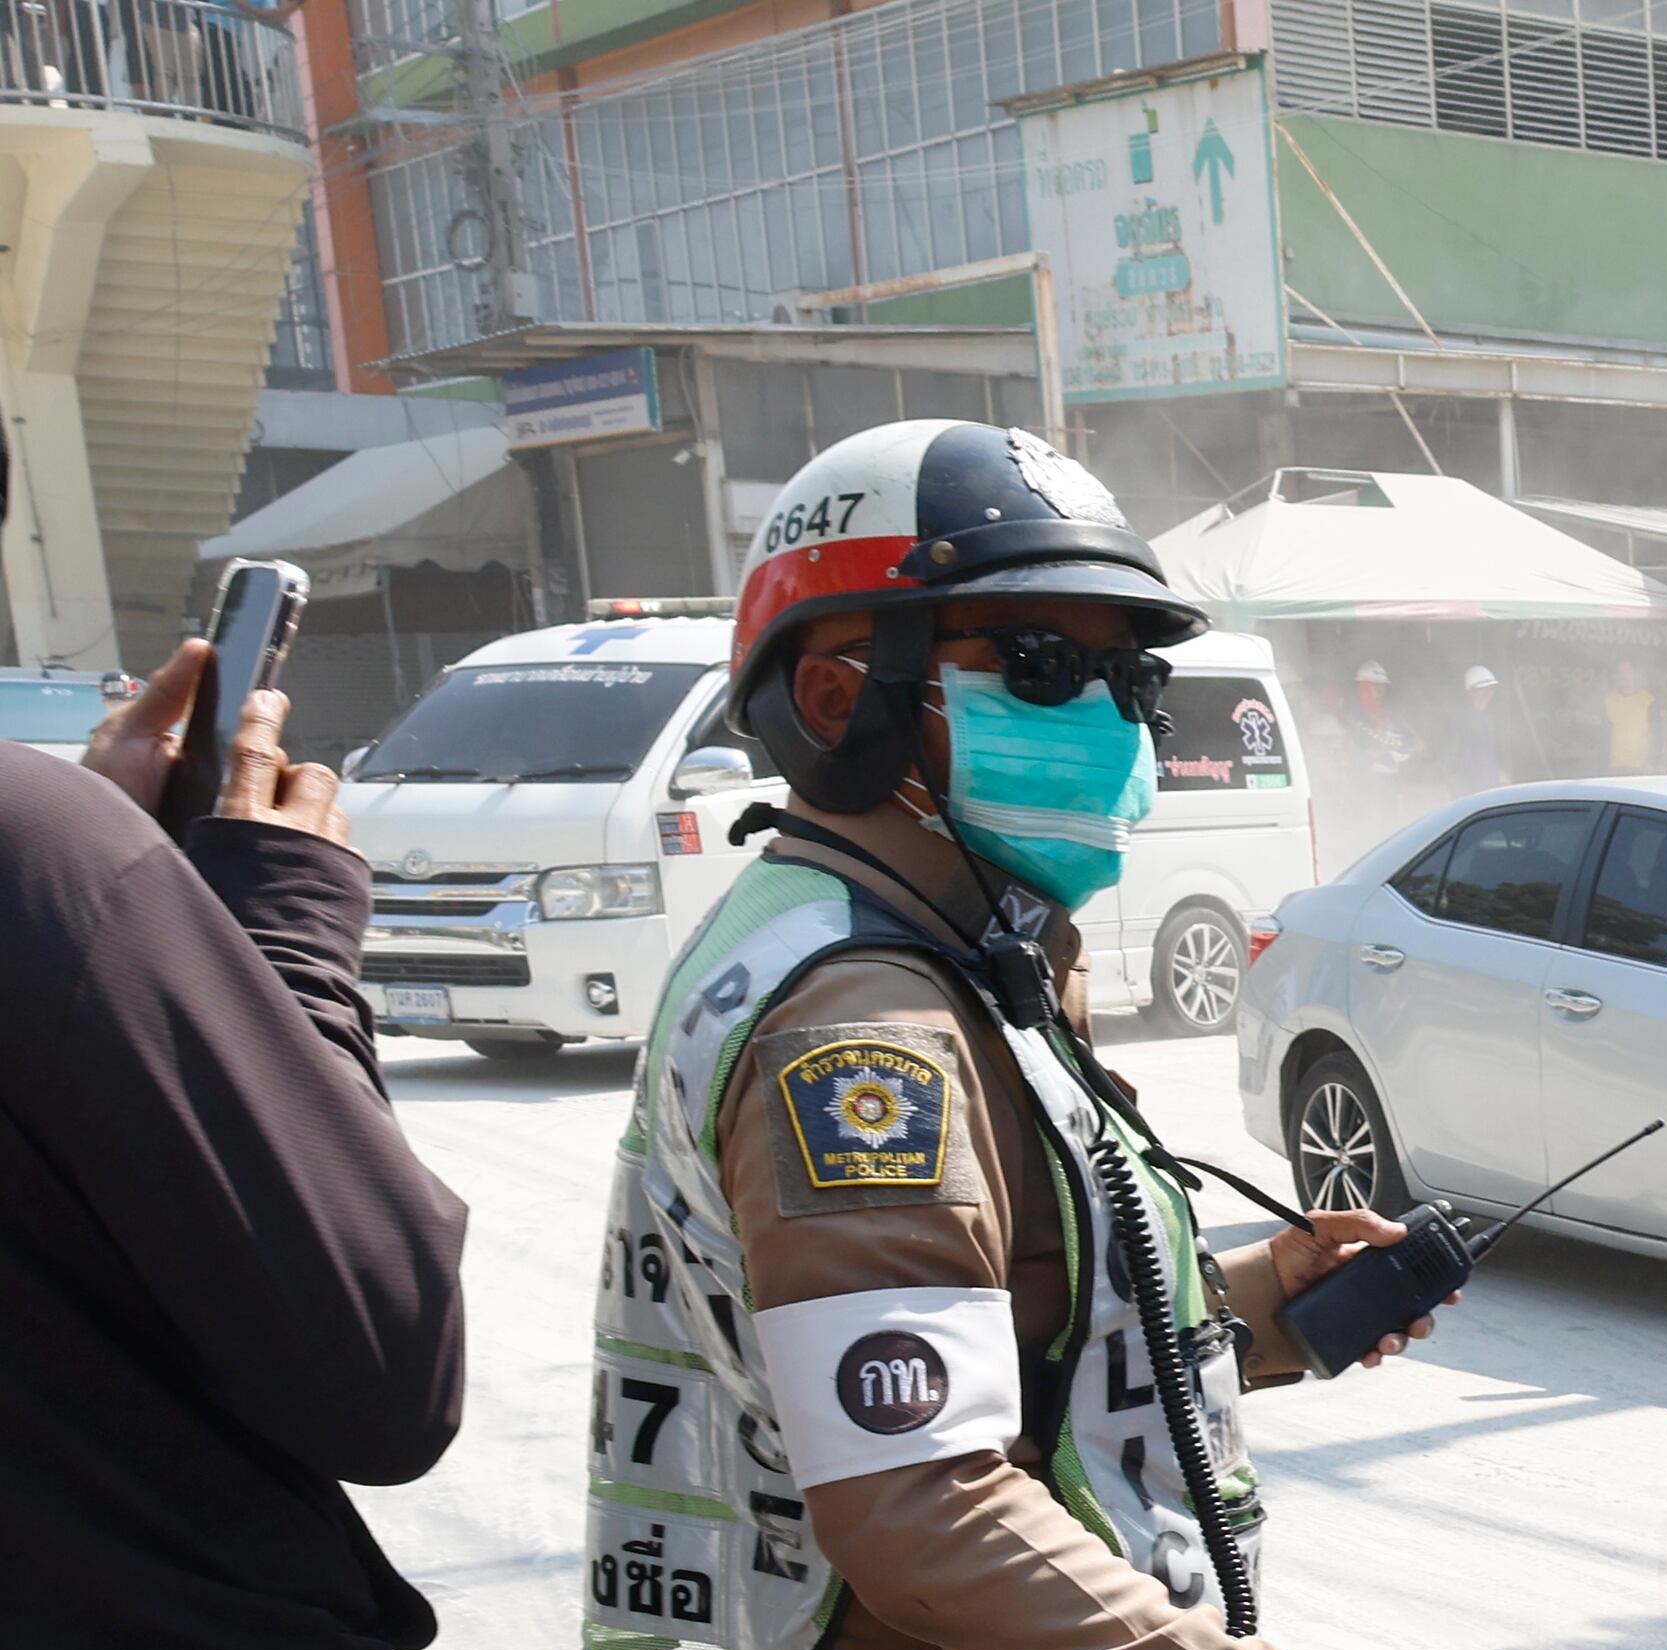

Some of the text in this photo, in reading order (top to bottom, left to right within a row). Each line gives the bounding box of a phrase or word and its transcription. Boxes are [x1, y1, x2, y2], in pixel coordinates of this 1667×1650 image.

[766, 492, 865, 553] 6647
[823, 1152, 926, 1165] METROPOLITAN
[845, 1164, 908, 1177] POLICE
